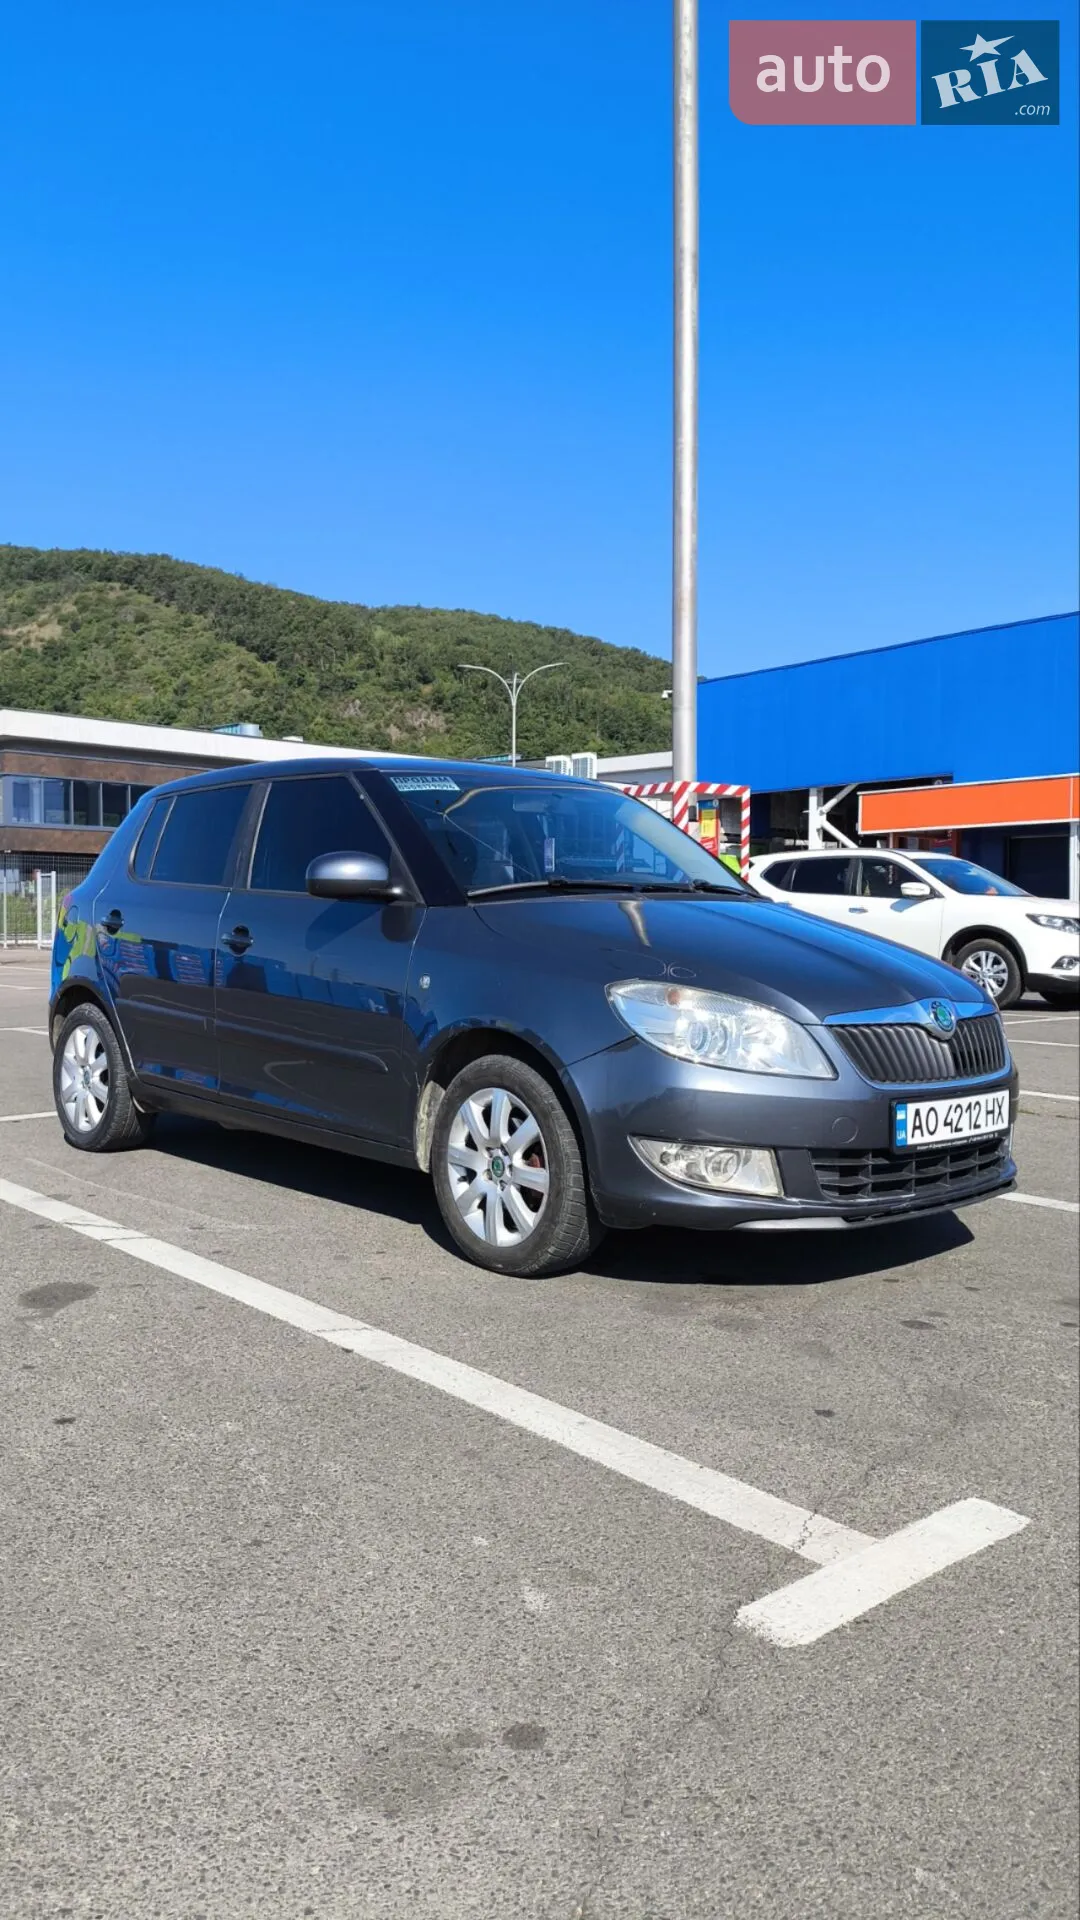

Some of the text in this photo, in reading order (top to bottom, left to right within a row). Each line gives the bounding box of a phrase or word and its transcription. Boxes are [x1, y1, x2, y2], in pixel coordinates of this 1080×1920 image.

[911, 1096, 1005, 1139] AO 4212 HX
[897, 1129, 906, 1139] UA
